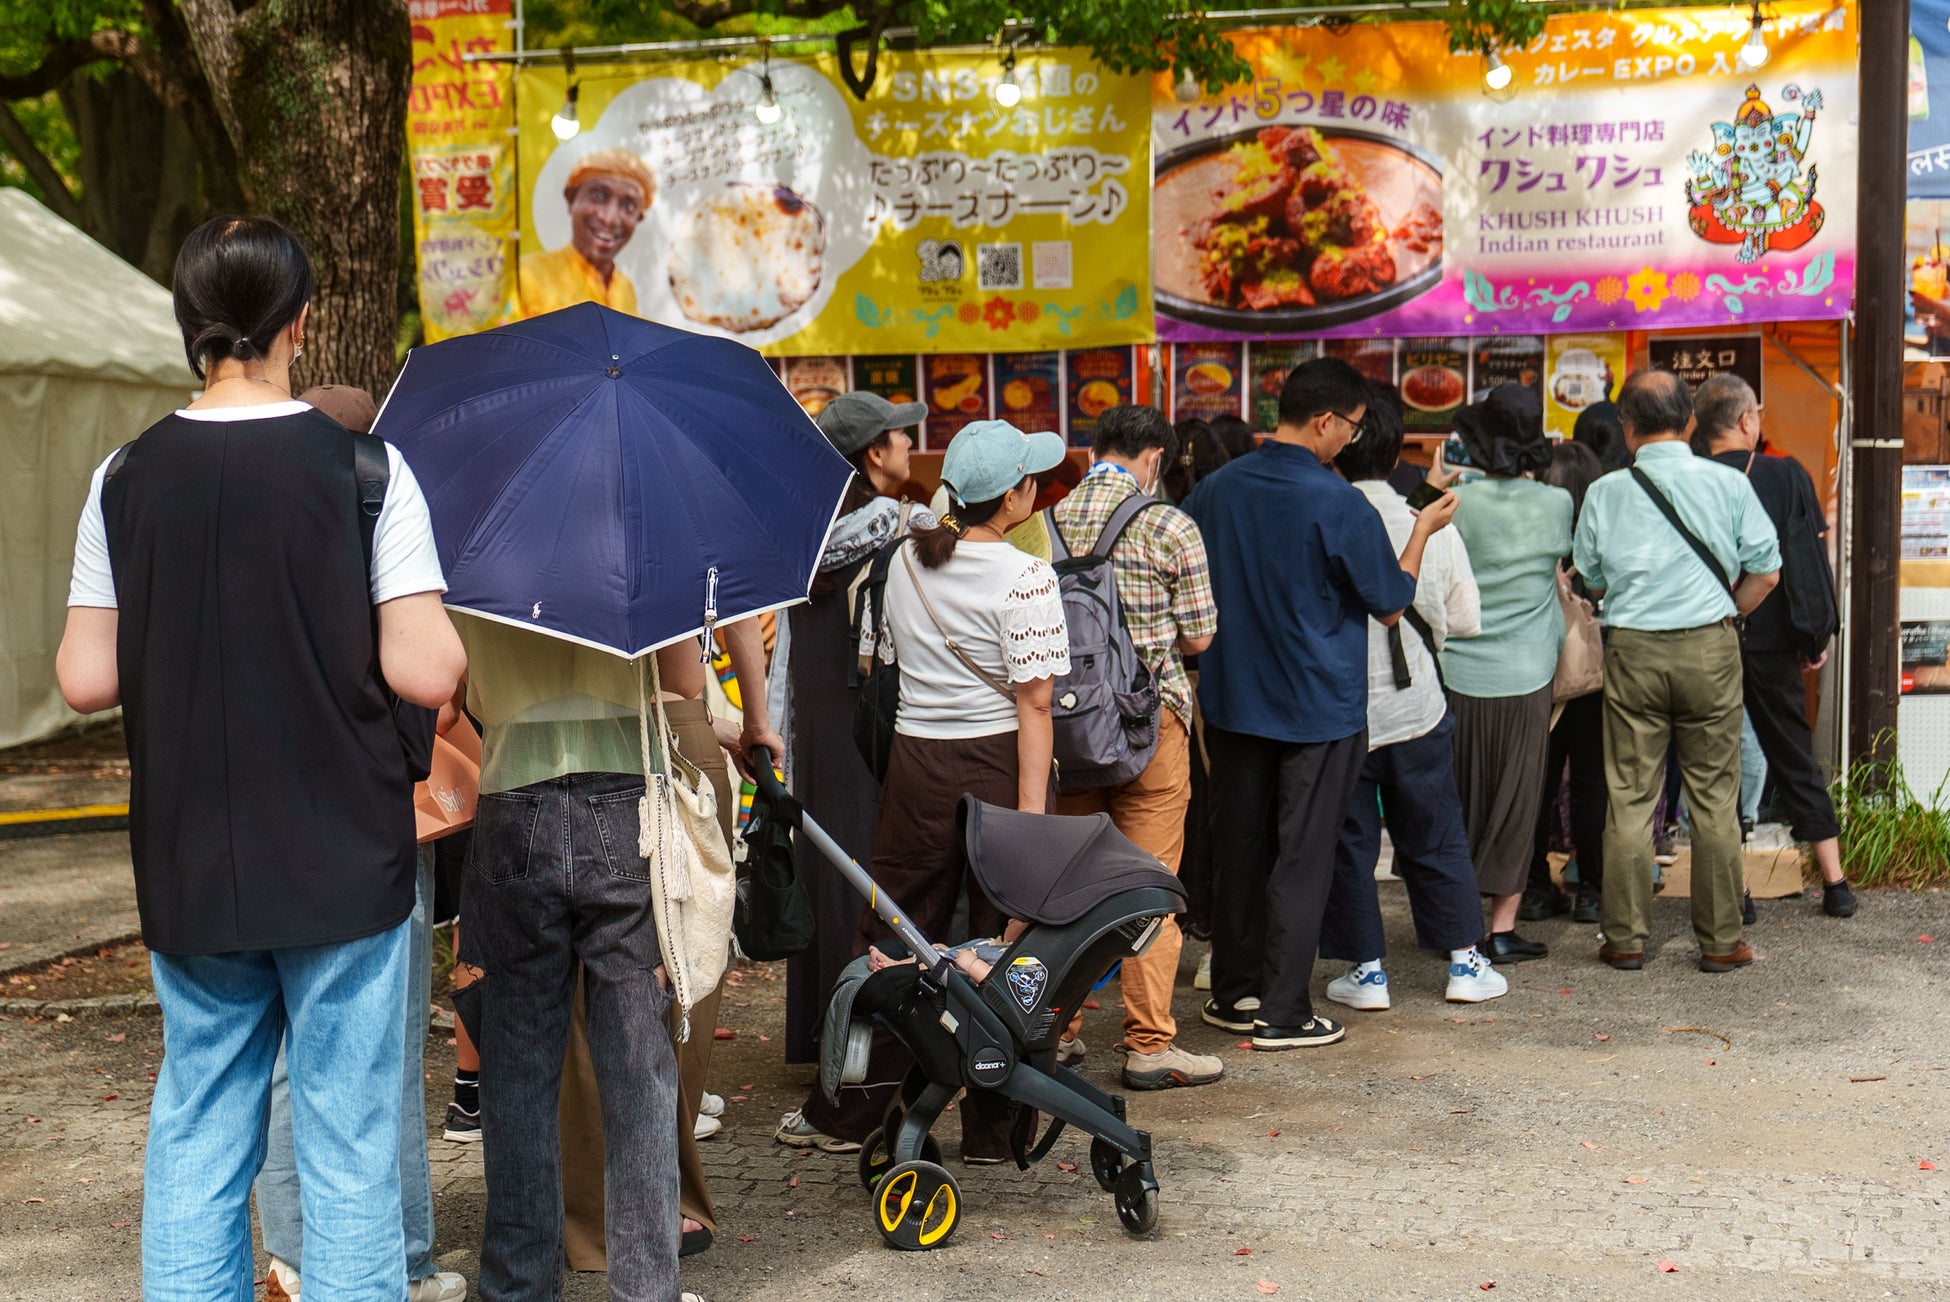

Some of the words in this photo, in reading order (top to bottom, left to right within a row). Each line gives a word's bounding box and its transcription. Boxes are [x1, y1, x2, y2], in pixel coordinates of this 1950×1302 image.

[1533, 61, 1605, 85] カレー
[1613, 53, 1696, 80] EXPO
[1172, 77, 1412, 137] インド5つ星の味
[864, 104, 1127, 140] チーズナンおじさん
[1478, 120, 1665, 150] インド料理専門店
[1479, 209, 1568, 231] KHUSH
[1575, 205, 1664, 228] KHUSH
[1479, 235, 1549, 254] Indian
[1557, 230, 1664, 251] restaurant
[1406, 351, 1462, 367] ビリヤニ
[1672, 348, 1737, 370] 注文口
